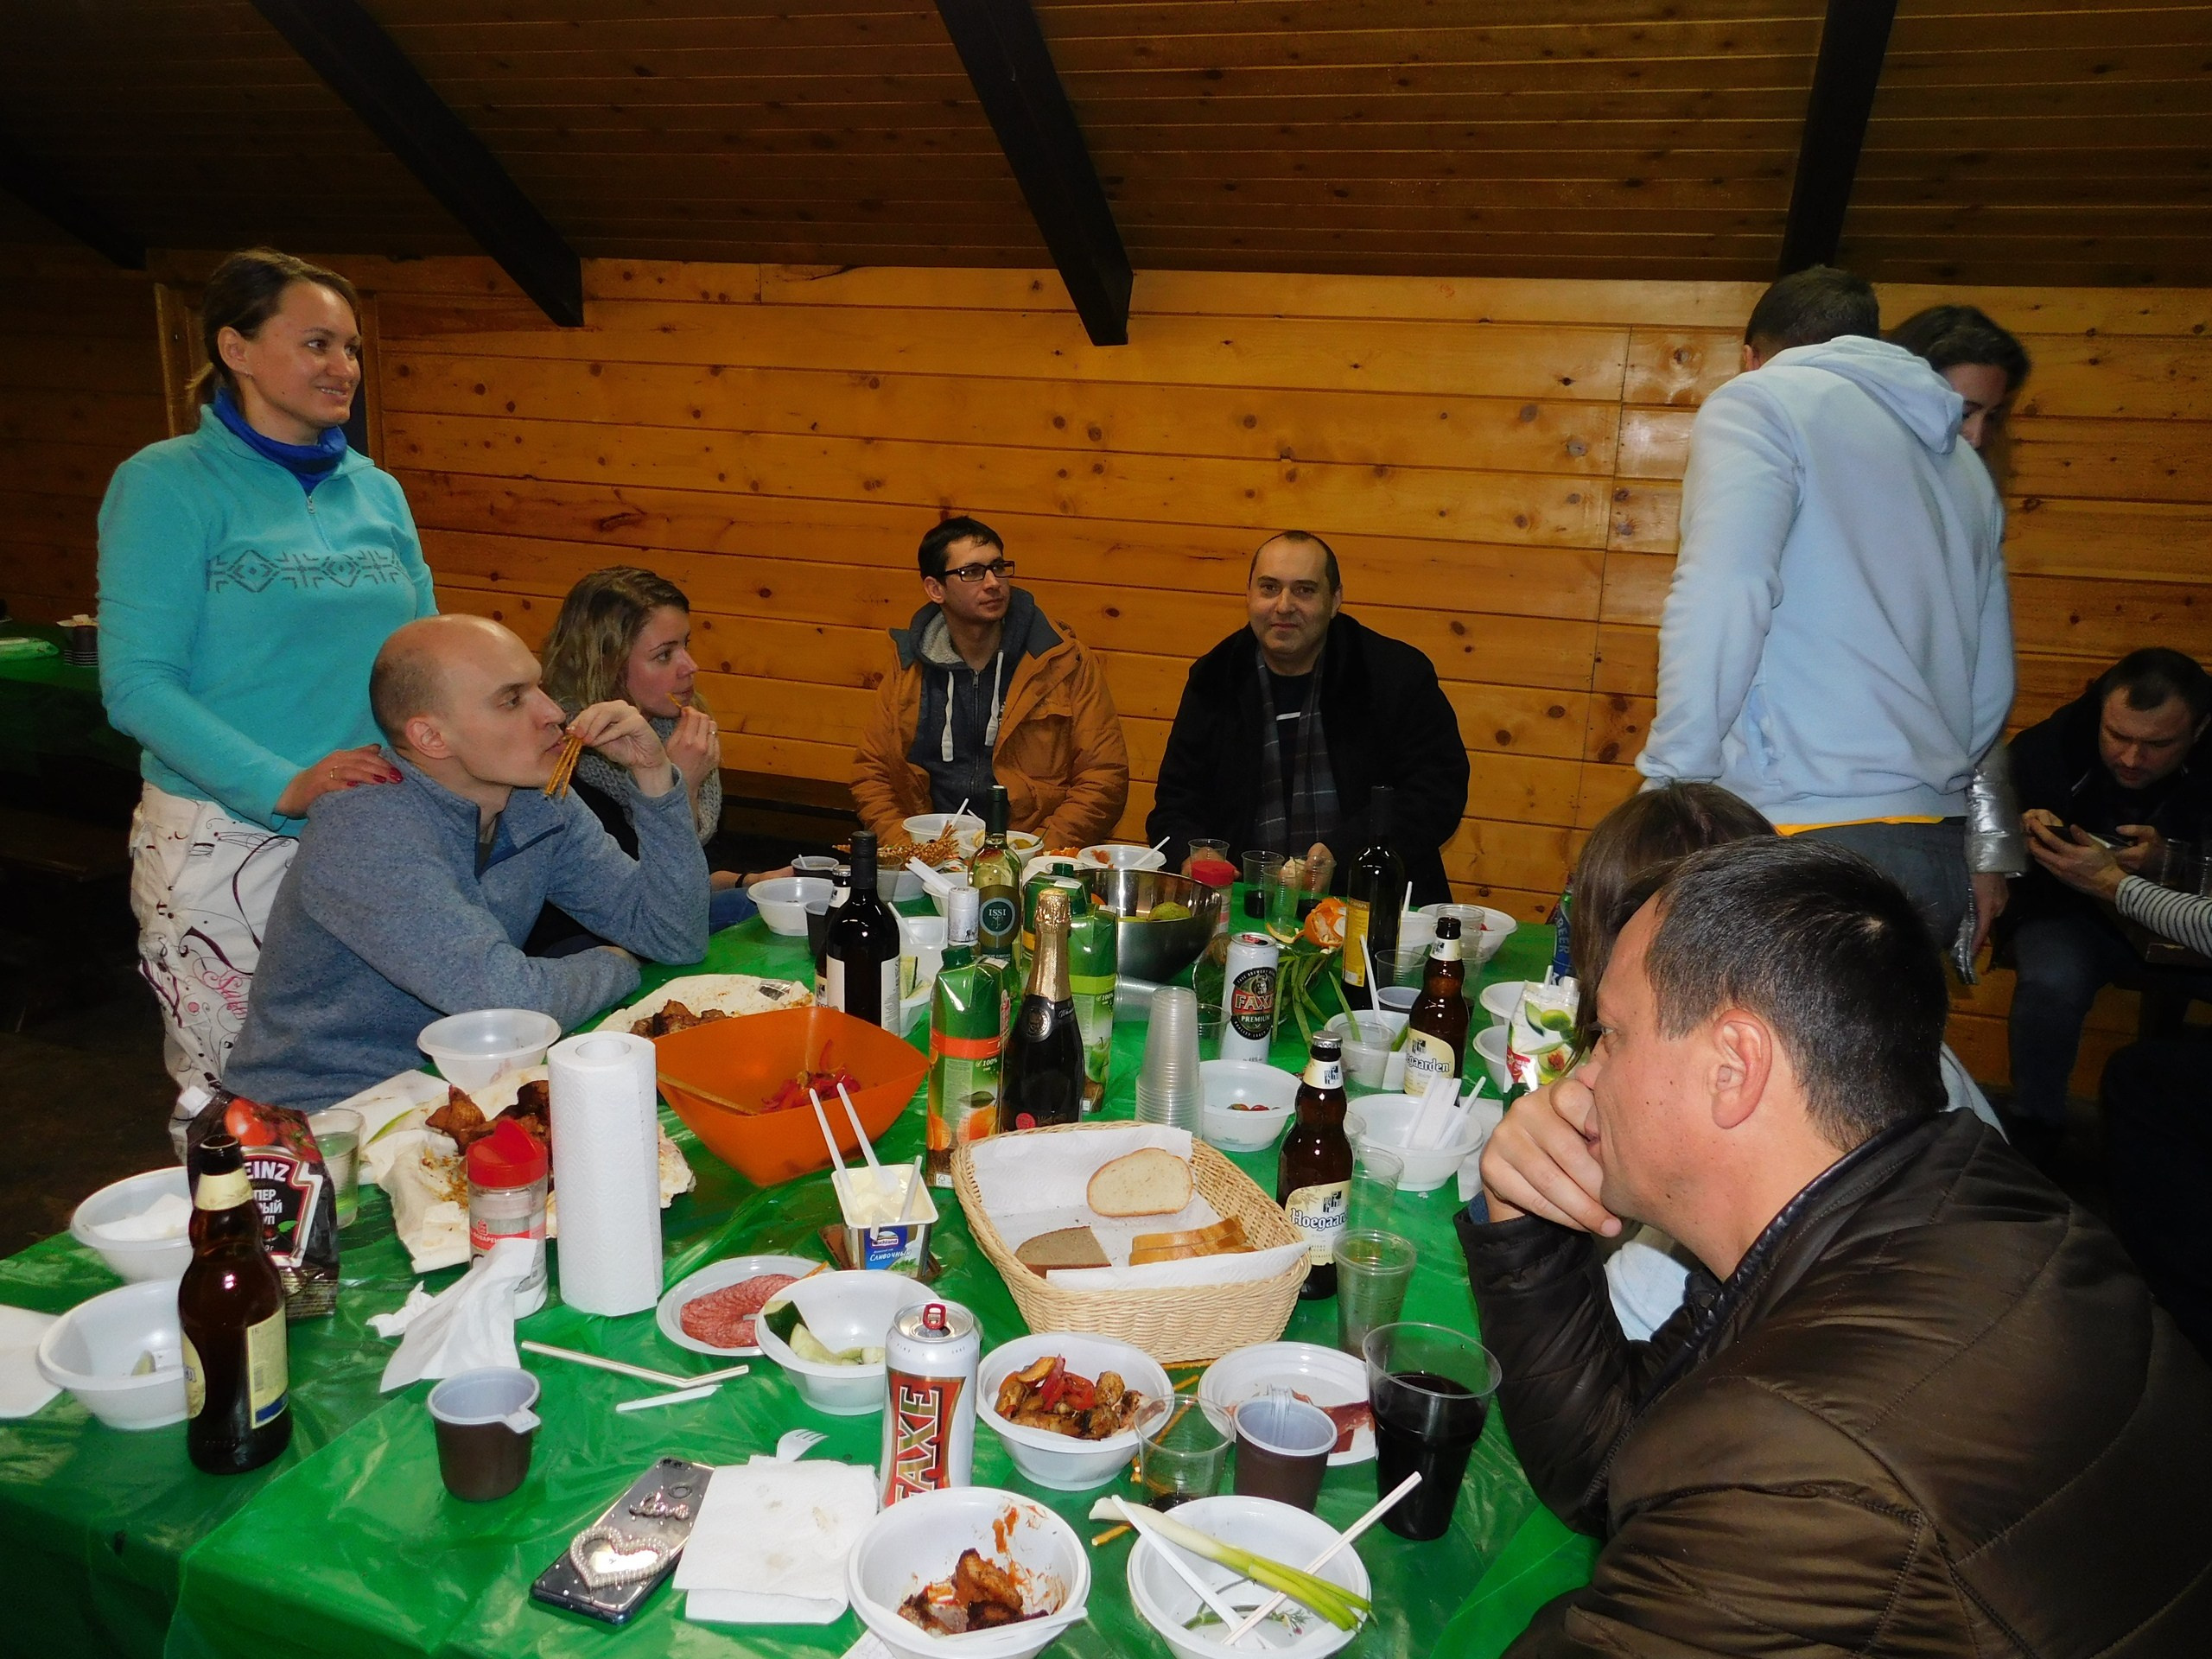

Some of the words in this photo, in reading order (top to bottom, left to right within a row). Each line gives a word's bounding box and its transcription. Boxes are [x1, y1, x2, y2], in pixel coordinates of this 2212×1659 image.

[988, 908, 1007, 917] ISSI
[1241, 1014, 1271, 1023] PREMIUM
[982, 1057, 998, 1067] 100%
[1406, 1053, 1451, 1073] gaarden
[244, 1160, 290, 1182] EINZ
[253, 1188, 276, 1201] ПЕР
[1290, 1206, 1349, 1231] Hoegaar
